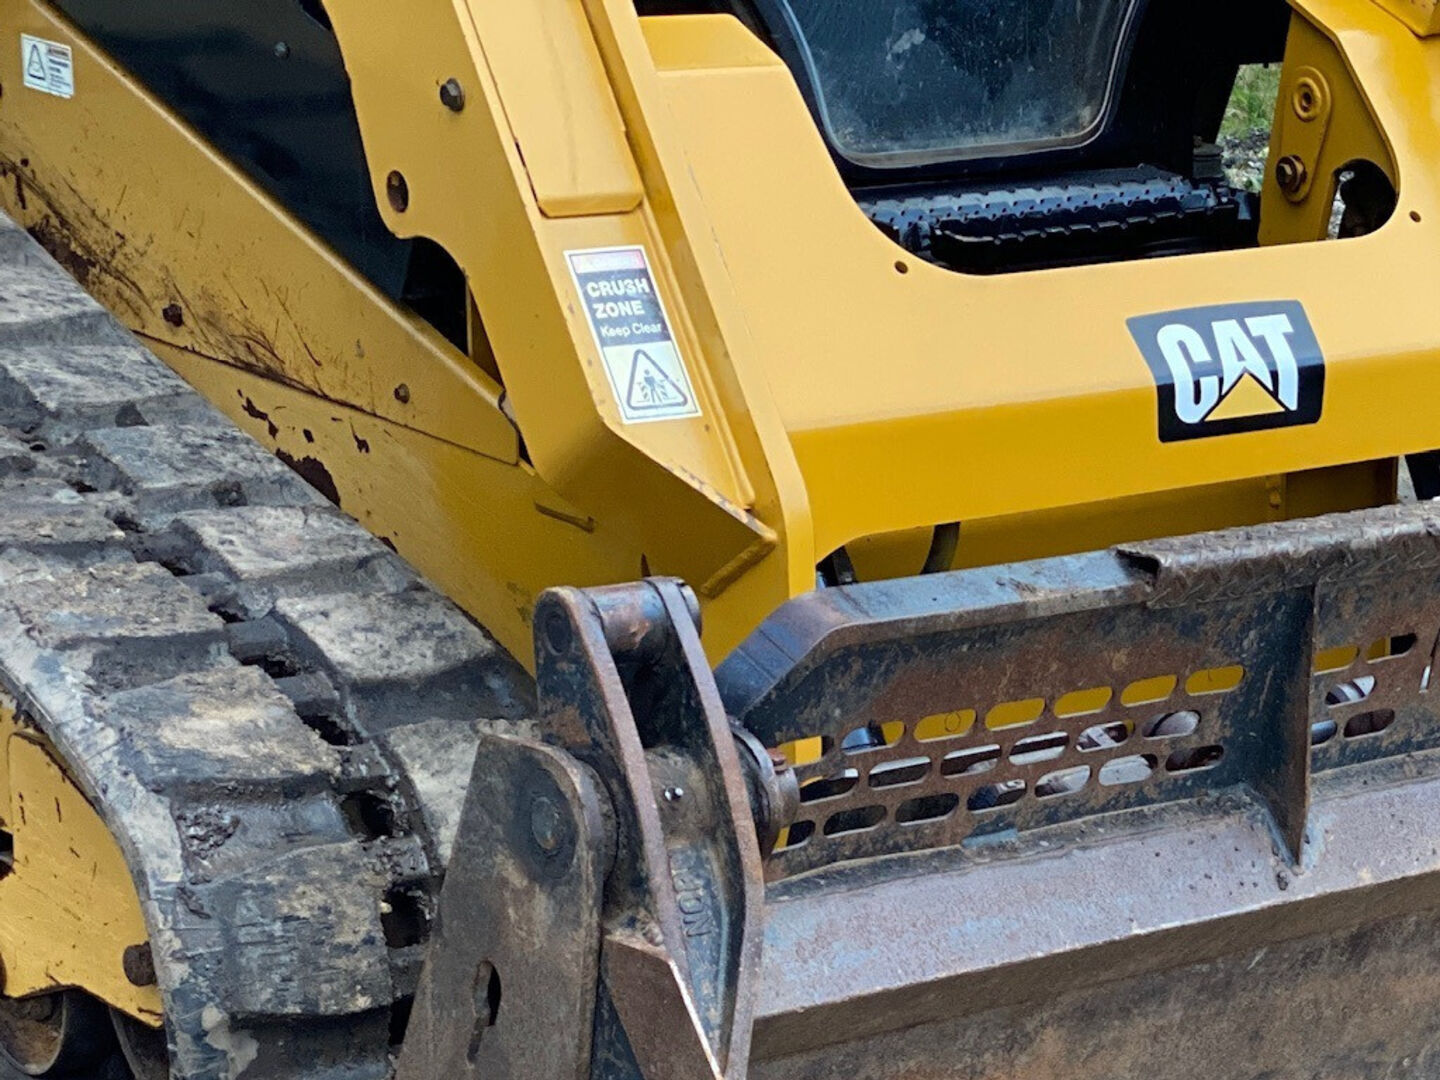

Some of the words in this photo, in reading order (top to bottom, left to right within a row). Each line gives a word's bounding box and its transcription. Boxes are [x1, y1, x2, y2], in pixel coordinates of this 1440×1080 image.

[586, 277, 650, 298] CRUSH
[593, 300, 646, 319] ZONE
[600, 324, 631, 338] Keep
[632, 321, 663, 336] Clear
[1156, 313, 1298, 424] CAT
